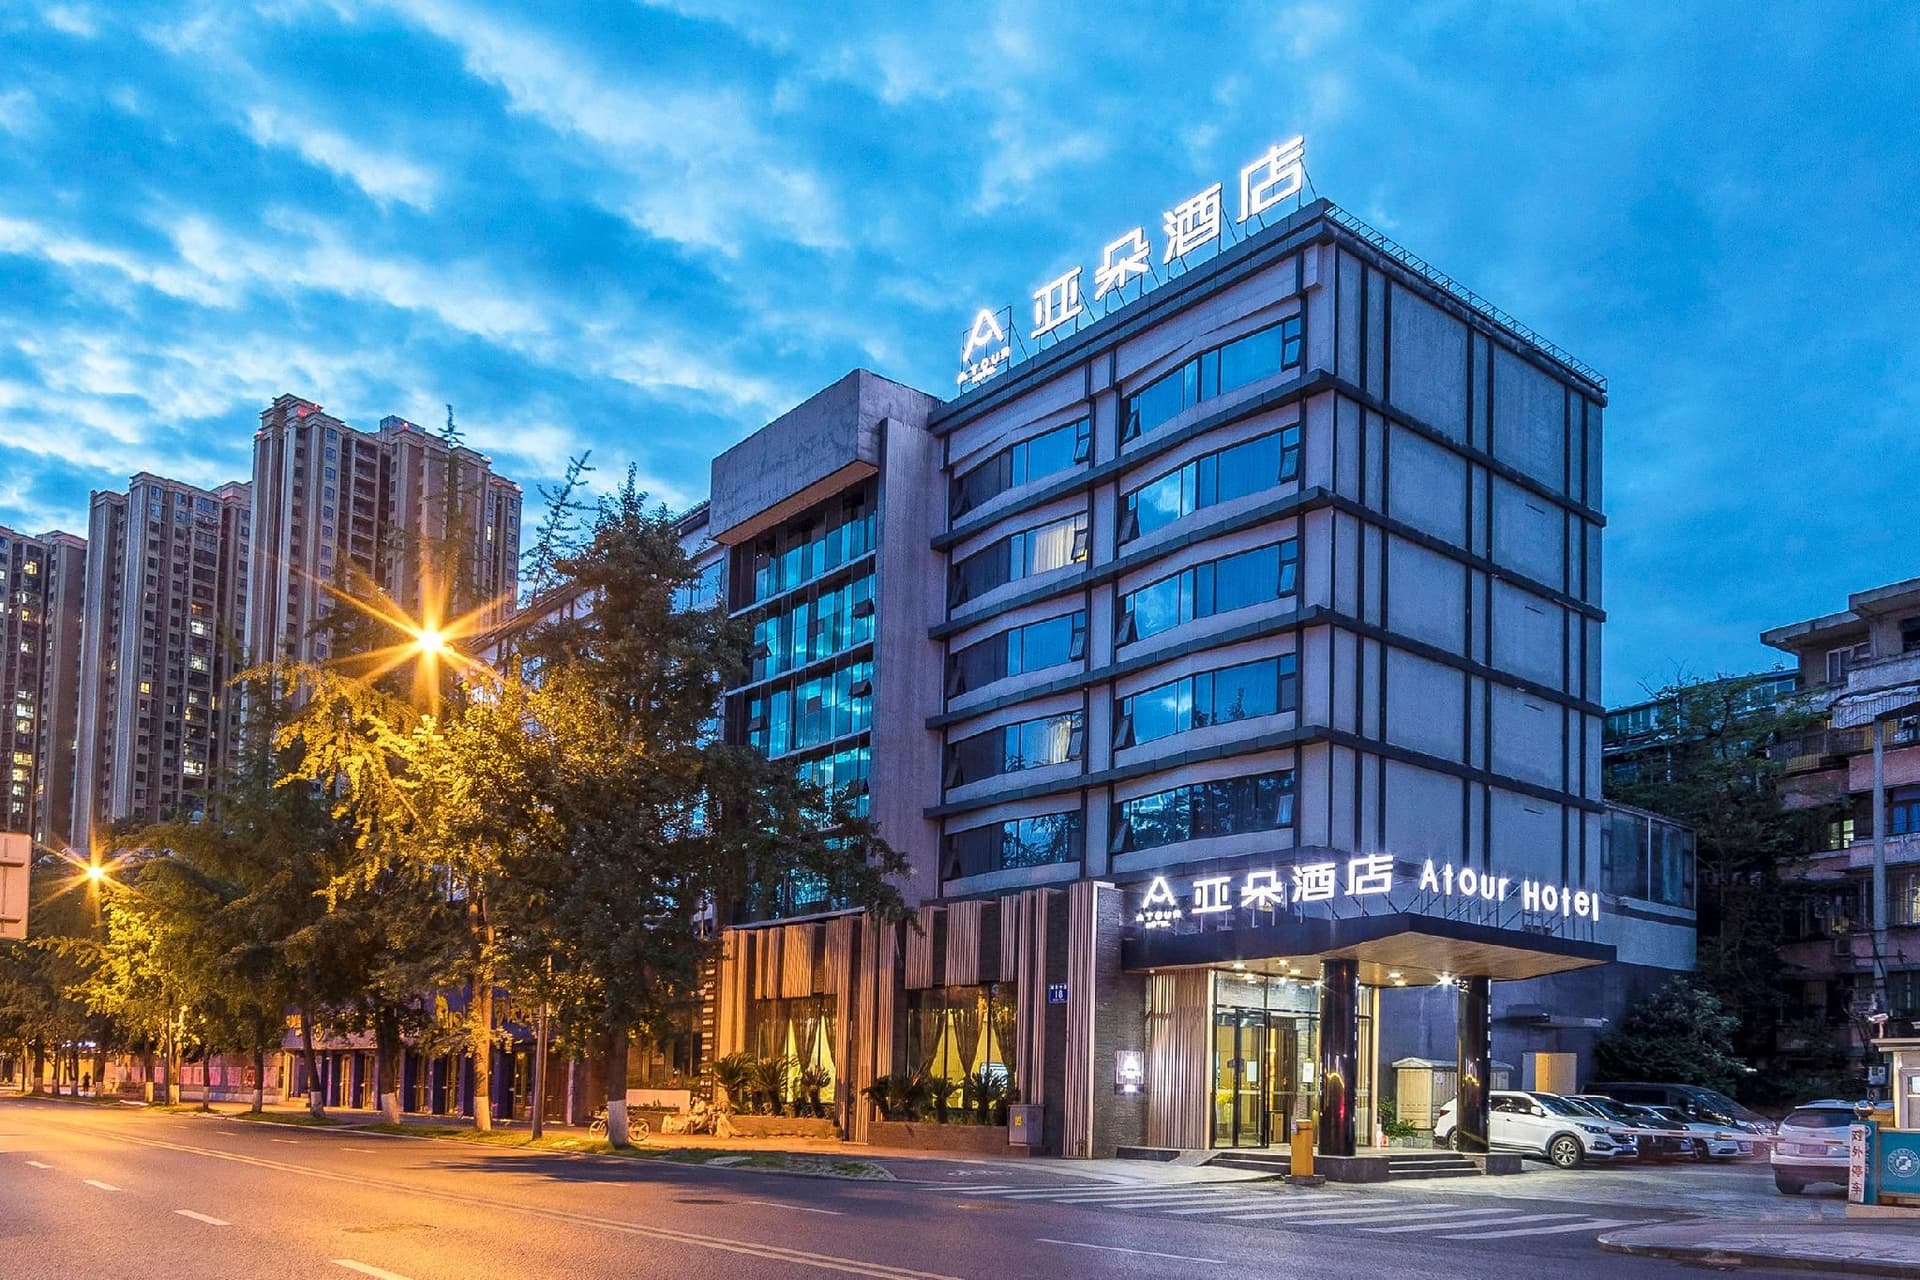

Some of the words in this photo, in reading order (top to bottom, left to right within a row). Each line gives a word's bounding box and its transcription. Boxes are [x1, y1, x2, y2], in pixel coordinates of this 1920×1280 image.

[1031, 135, 1305, 339] 亚朵酒店
[1191, 854, 1394, 914] 亚朵酒店
[1419, 857, 1510, 902] Atour
[1523, 878, 1600, 922] Hotel
[1135, 909, 1182, 922] ATOUR
